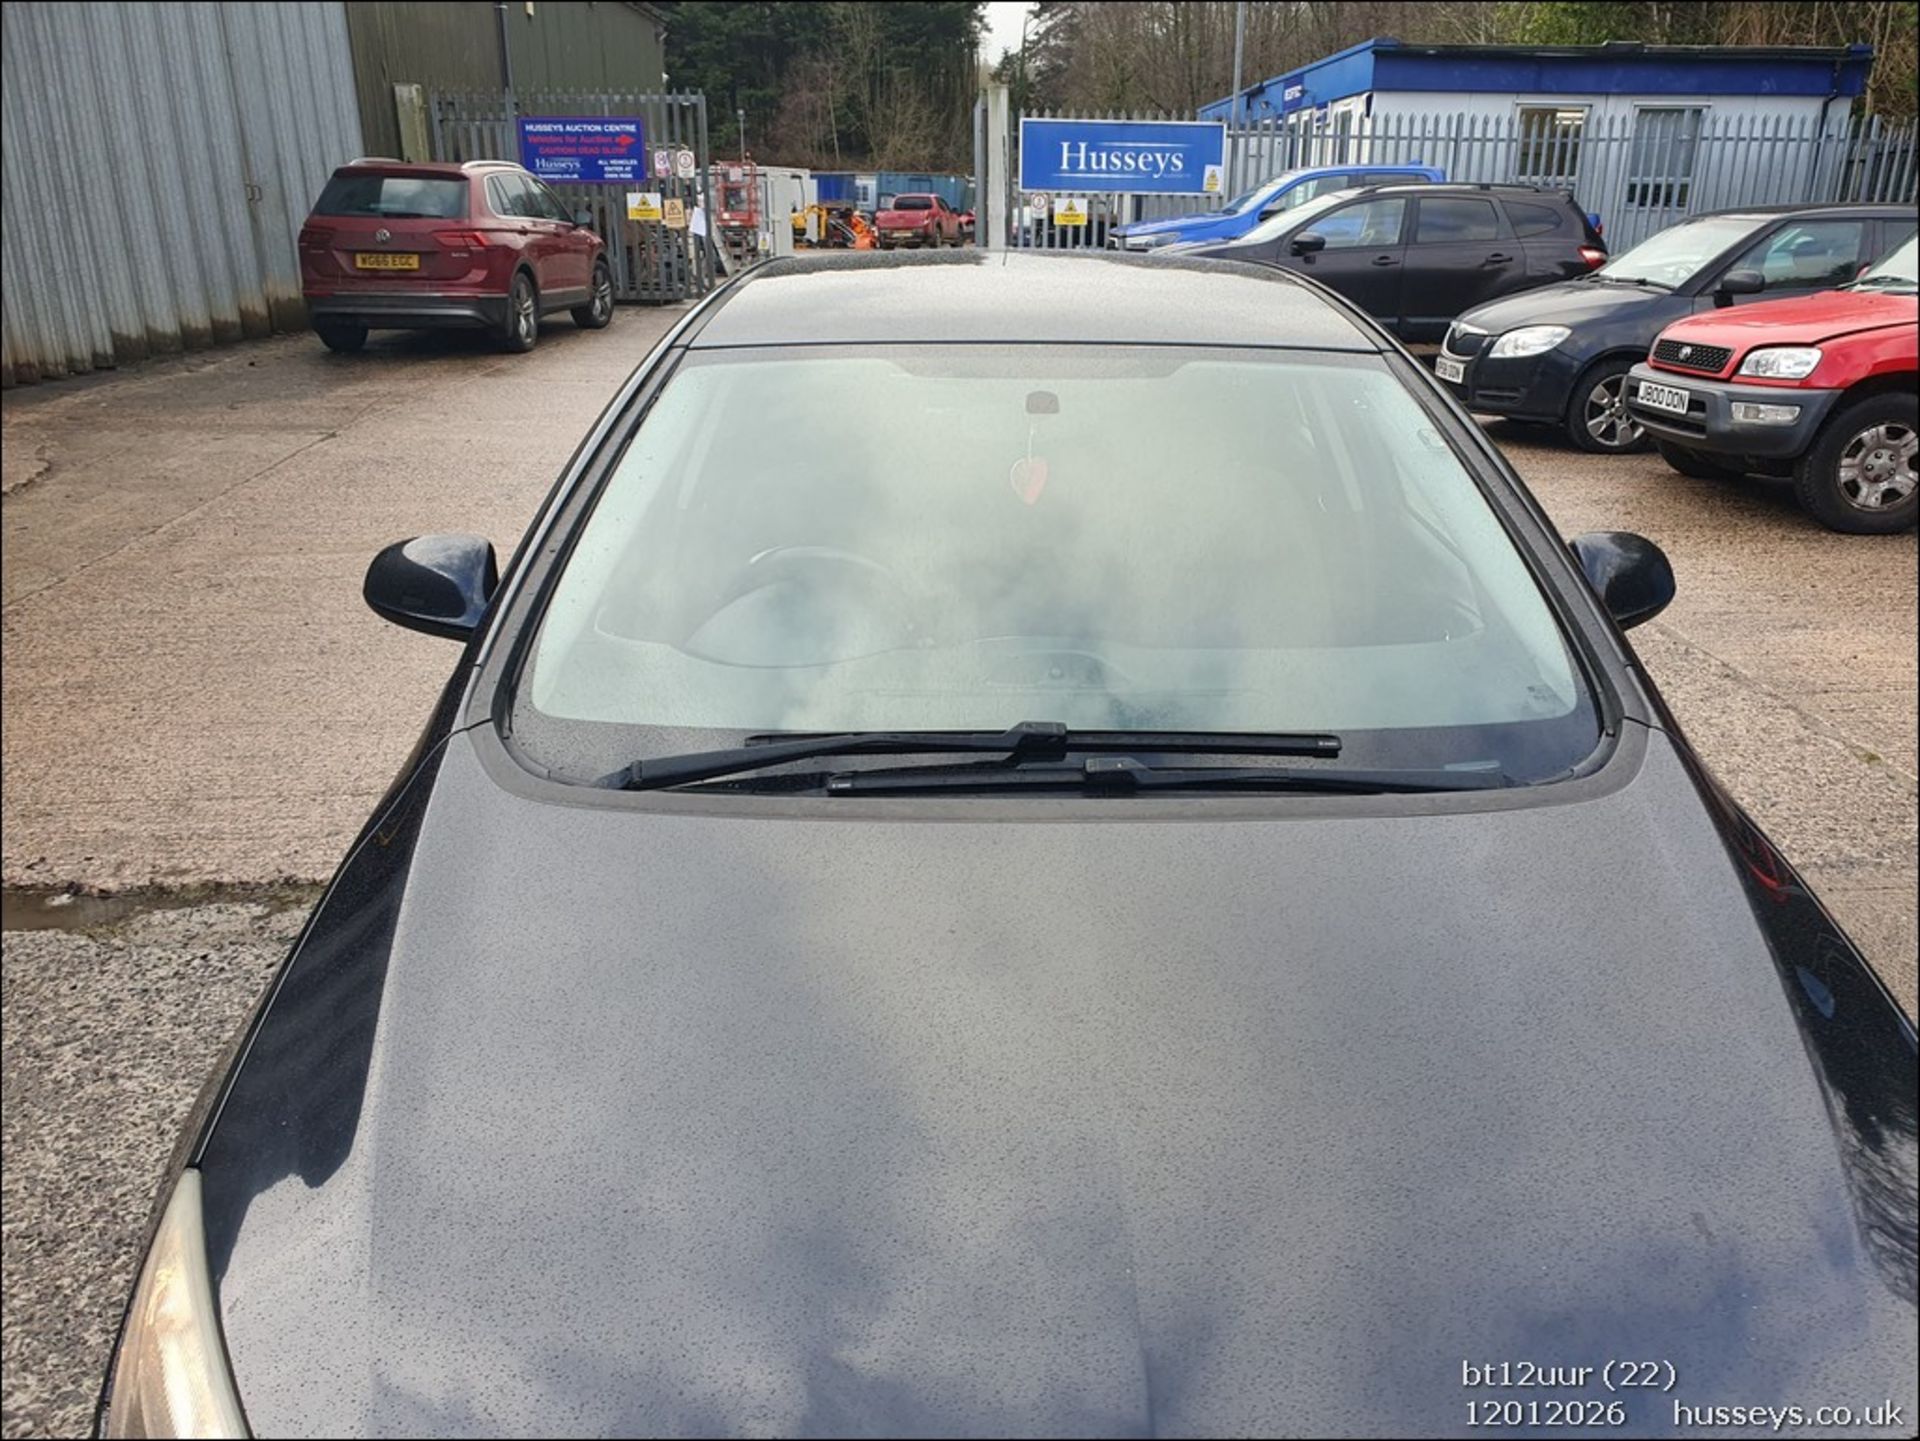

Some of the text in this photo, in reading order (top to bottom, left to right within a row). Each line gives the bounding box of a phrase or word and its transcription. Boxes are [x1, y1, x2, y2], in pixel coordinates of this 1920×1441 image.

[525, 124, 636, 132] HUSSEYS AUCTION CENTRE
[580, 135, 613, 144] Auction
[535, 158, 581, 171] Husseys
[1060, 142, 1184, 179] Husseys
